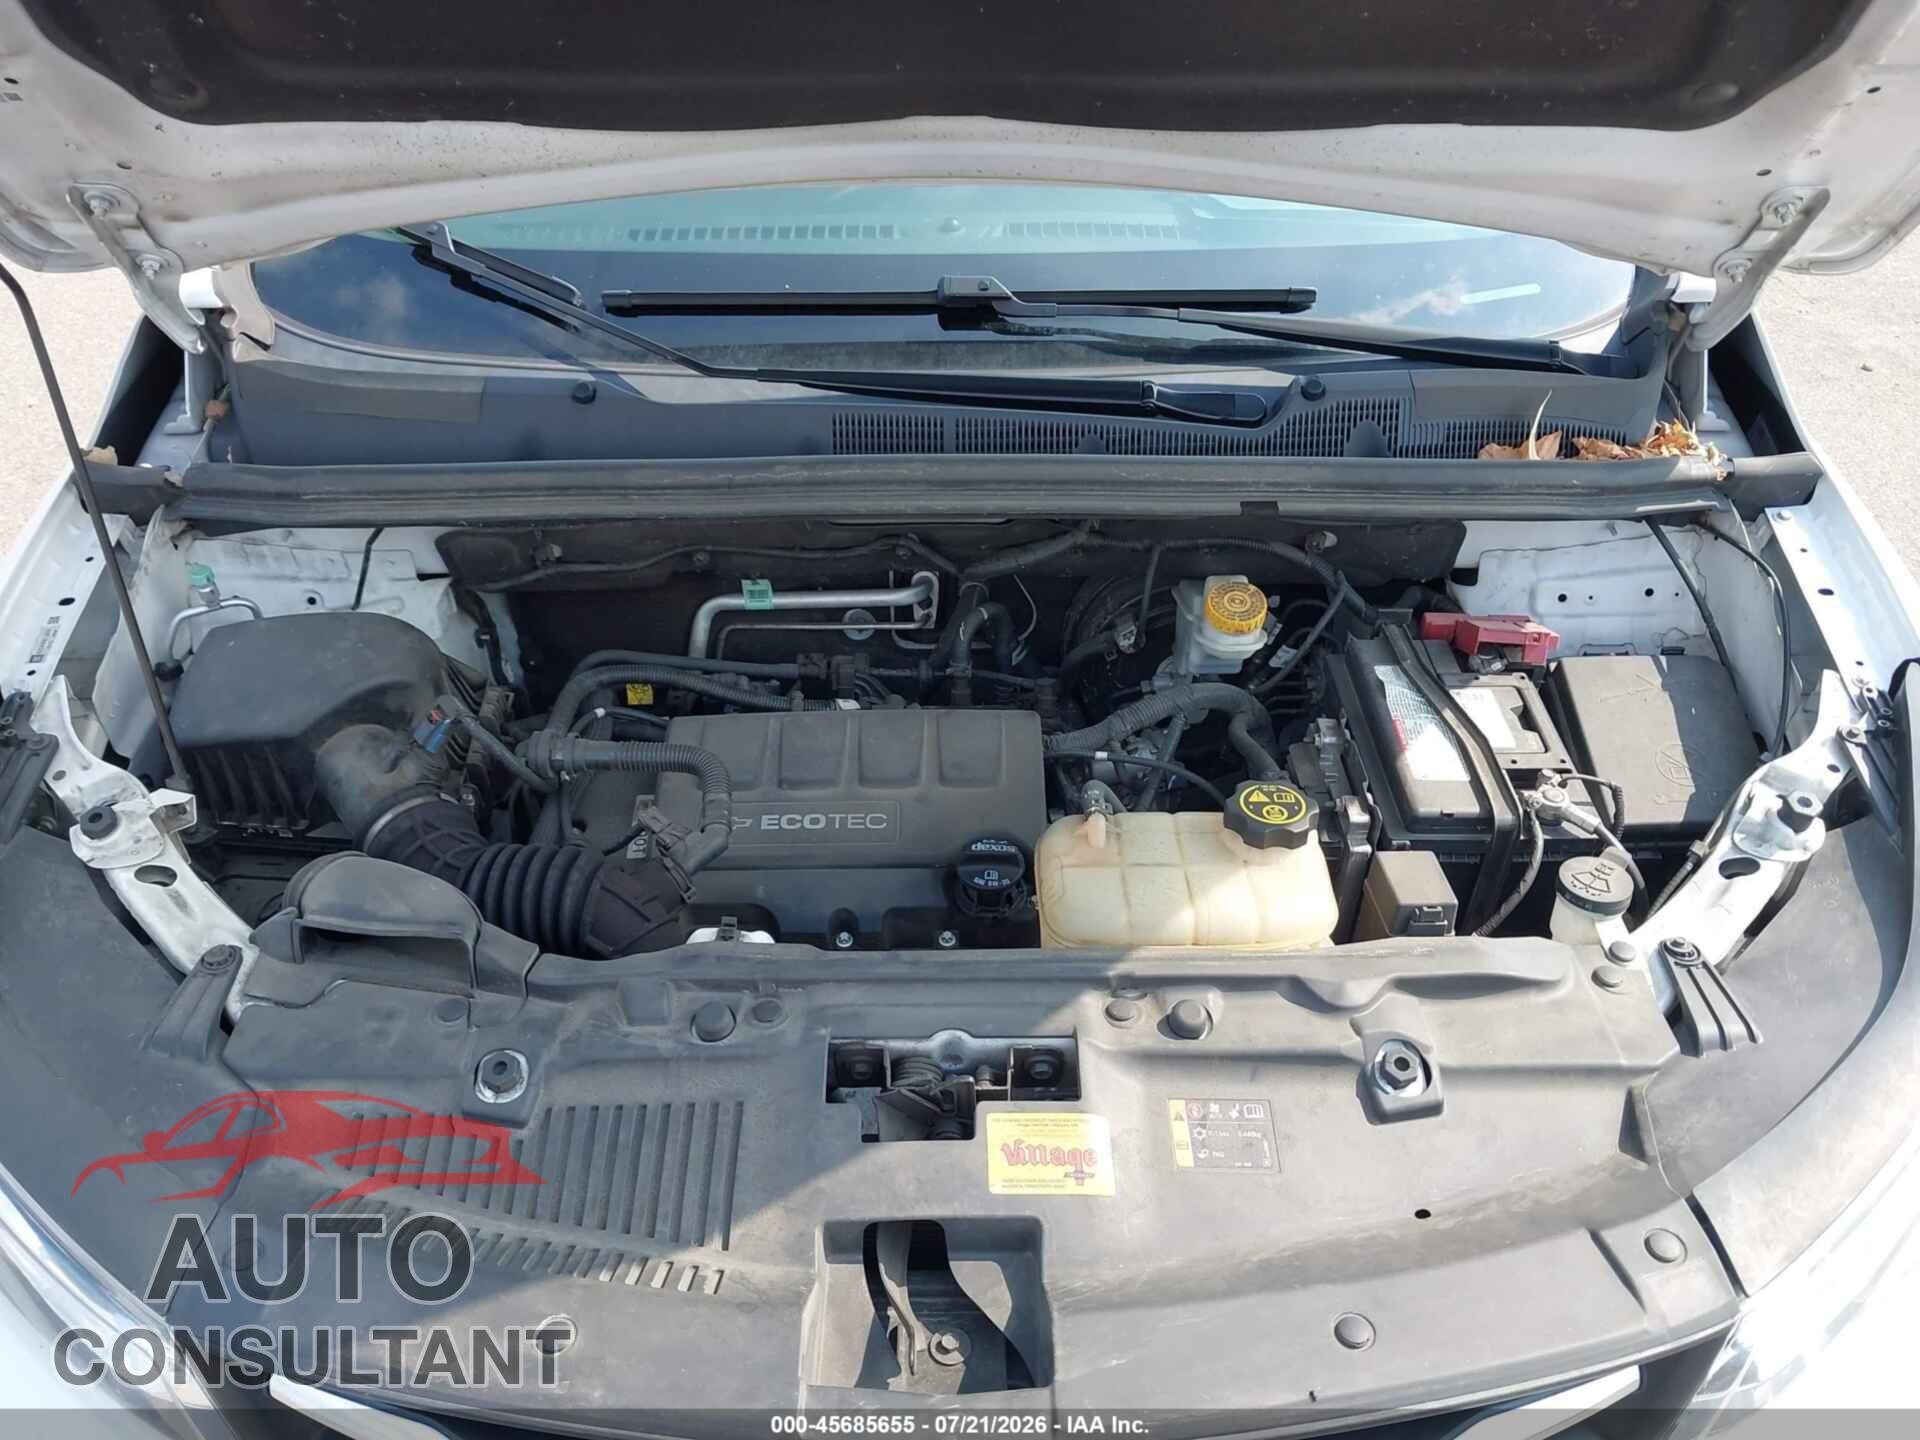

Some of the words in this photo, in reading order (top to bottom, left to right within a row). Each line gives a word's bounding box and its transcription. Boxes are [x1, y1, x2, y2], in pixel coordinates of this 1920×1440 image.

[760, 814, 888, 830] ECOTEC
[971, 842, 1018, 853] dexos
[1000, 1138, 1098, 1172] Village
